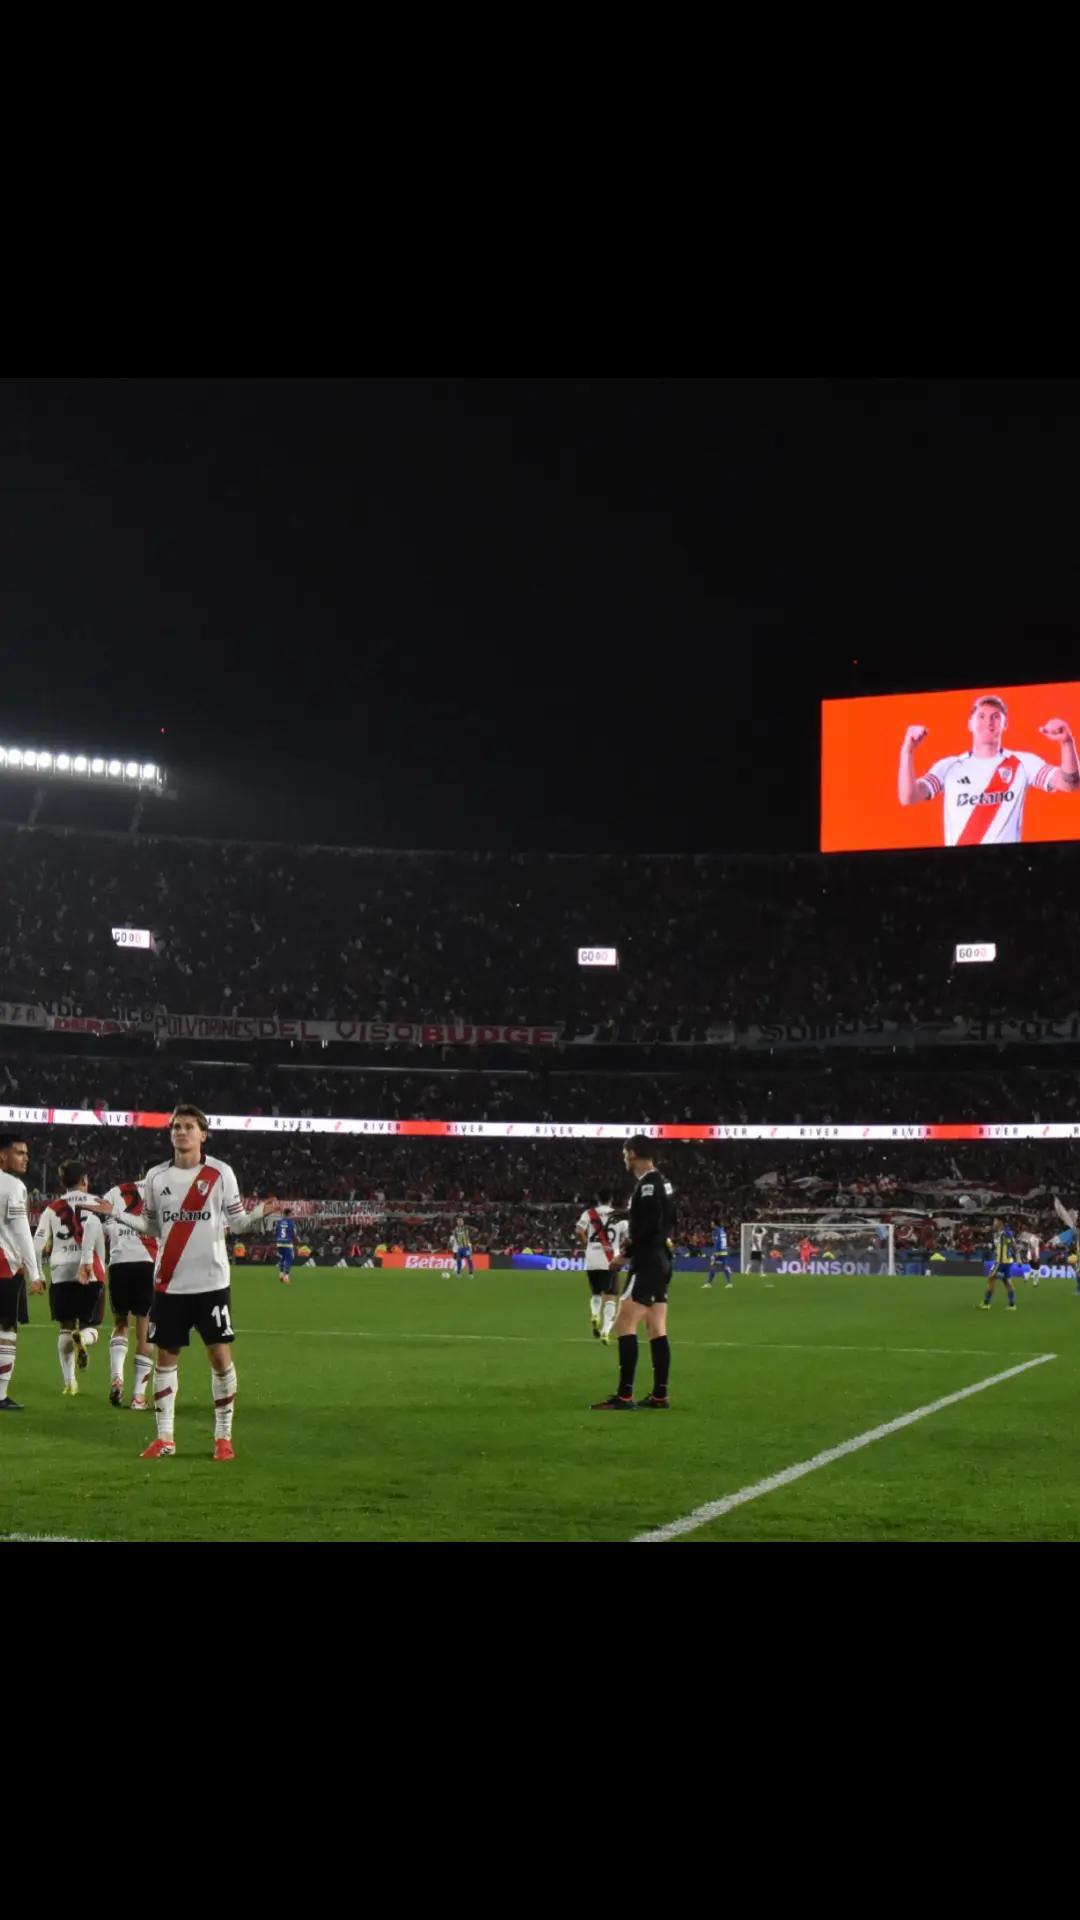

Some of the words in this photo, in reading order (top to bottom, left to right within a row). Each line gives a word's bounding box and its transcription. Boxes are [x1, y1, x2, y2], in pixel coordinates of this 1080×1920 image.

[957, 790, 1014, 806] Betano
[259, 1019, 320, 1039] DEL
[421, 1025, 556, 1045] BUDGE
[9, 1109, 48, 1119] RIVER
[274, 1120, 311, 1129] RIVER
[363, 1122, 401, 1131] RIVER
[446, 1123, 484, 1132] RIVER
[535, 1125, 573, 1134] RIVER
[625, 1126, 664, 1136] RIVER
[708, 1127, 748, 1136] RIVER
[799, 1127, 838, 1136] RIVER
[892, 1127, 931, 1136] RIVER
[978, 1127, 1018, 1136] RIVER
[162, 1210, 212, 1223] Betano
[281, 1227, 288, 1239] 5
[211, 1304, 231, 1328] 11
